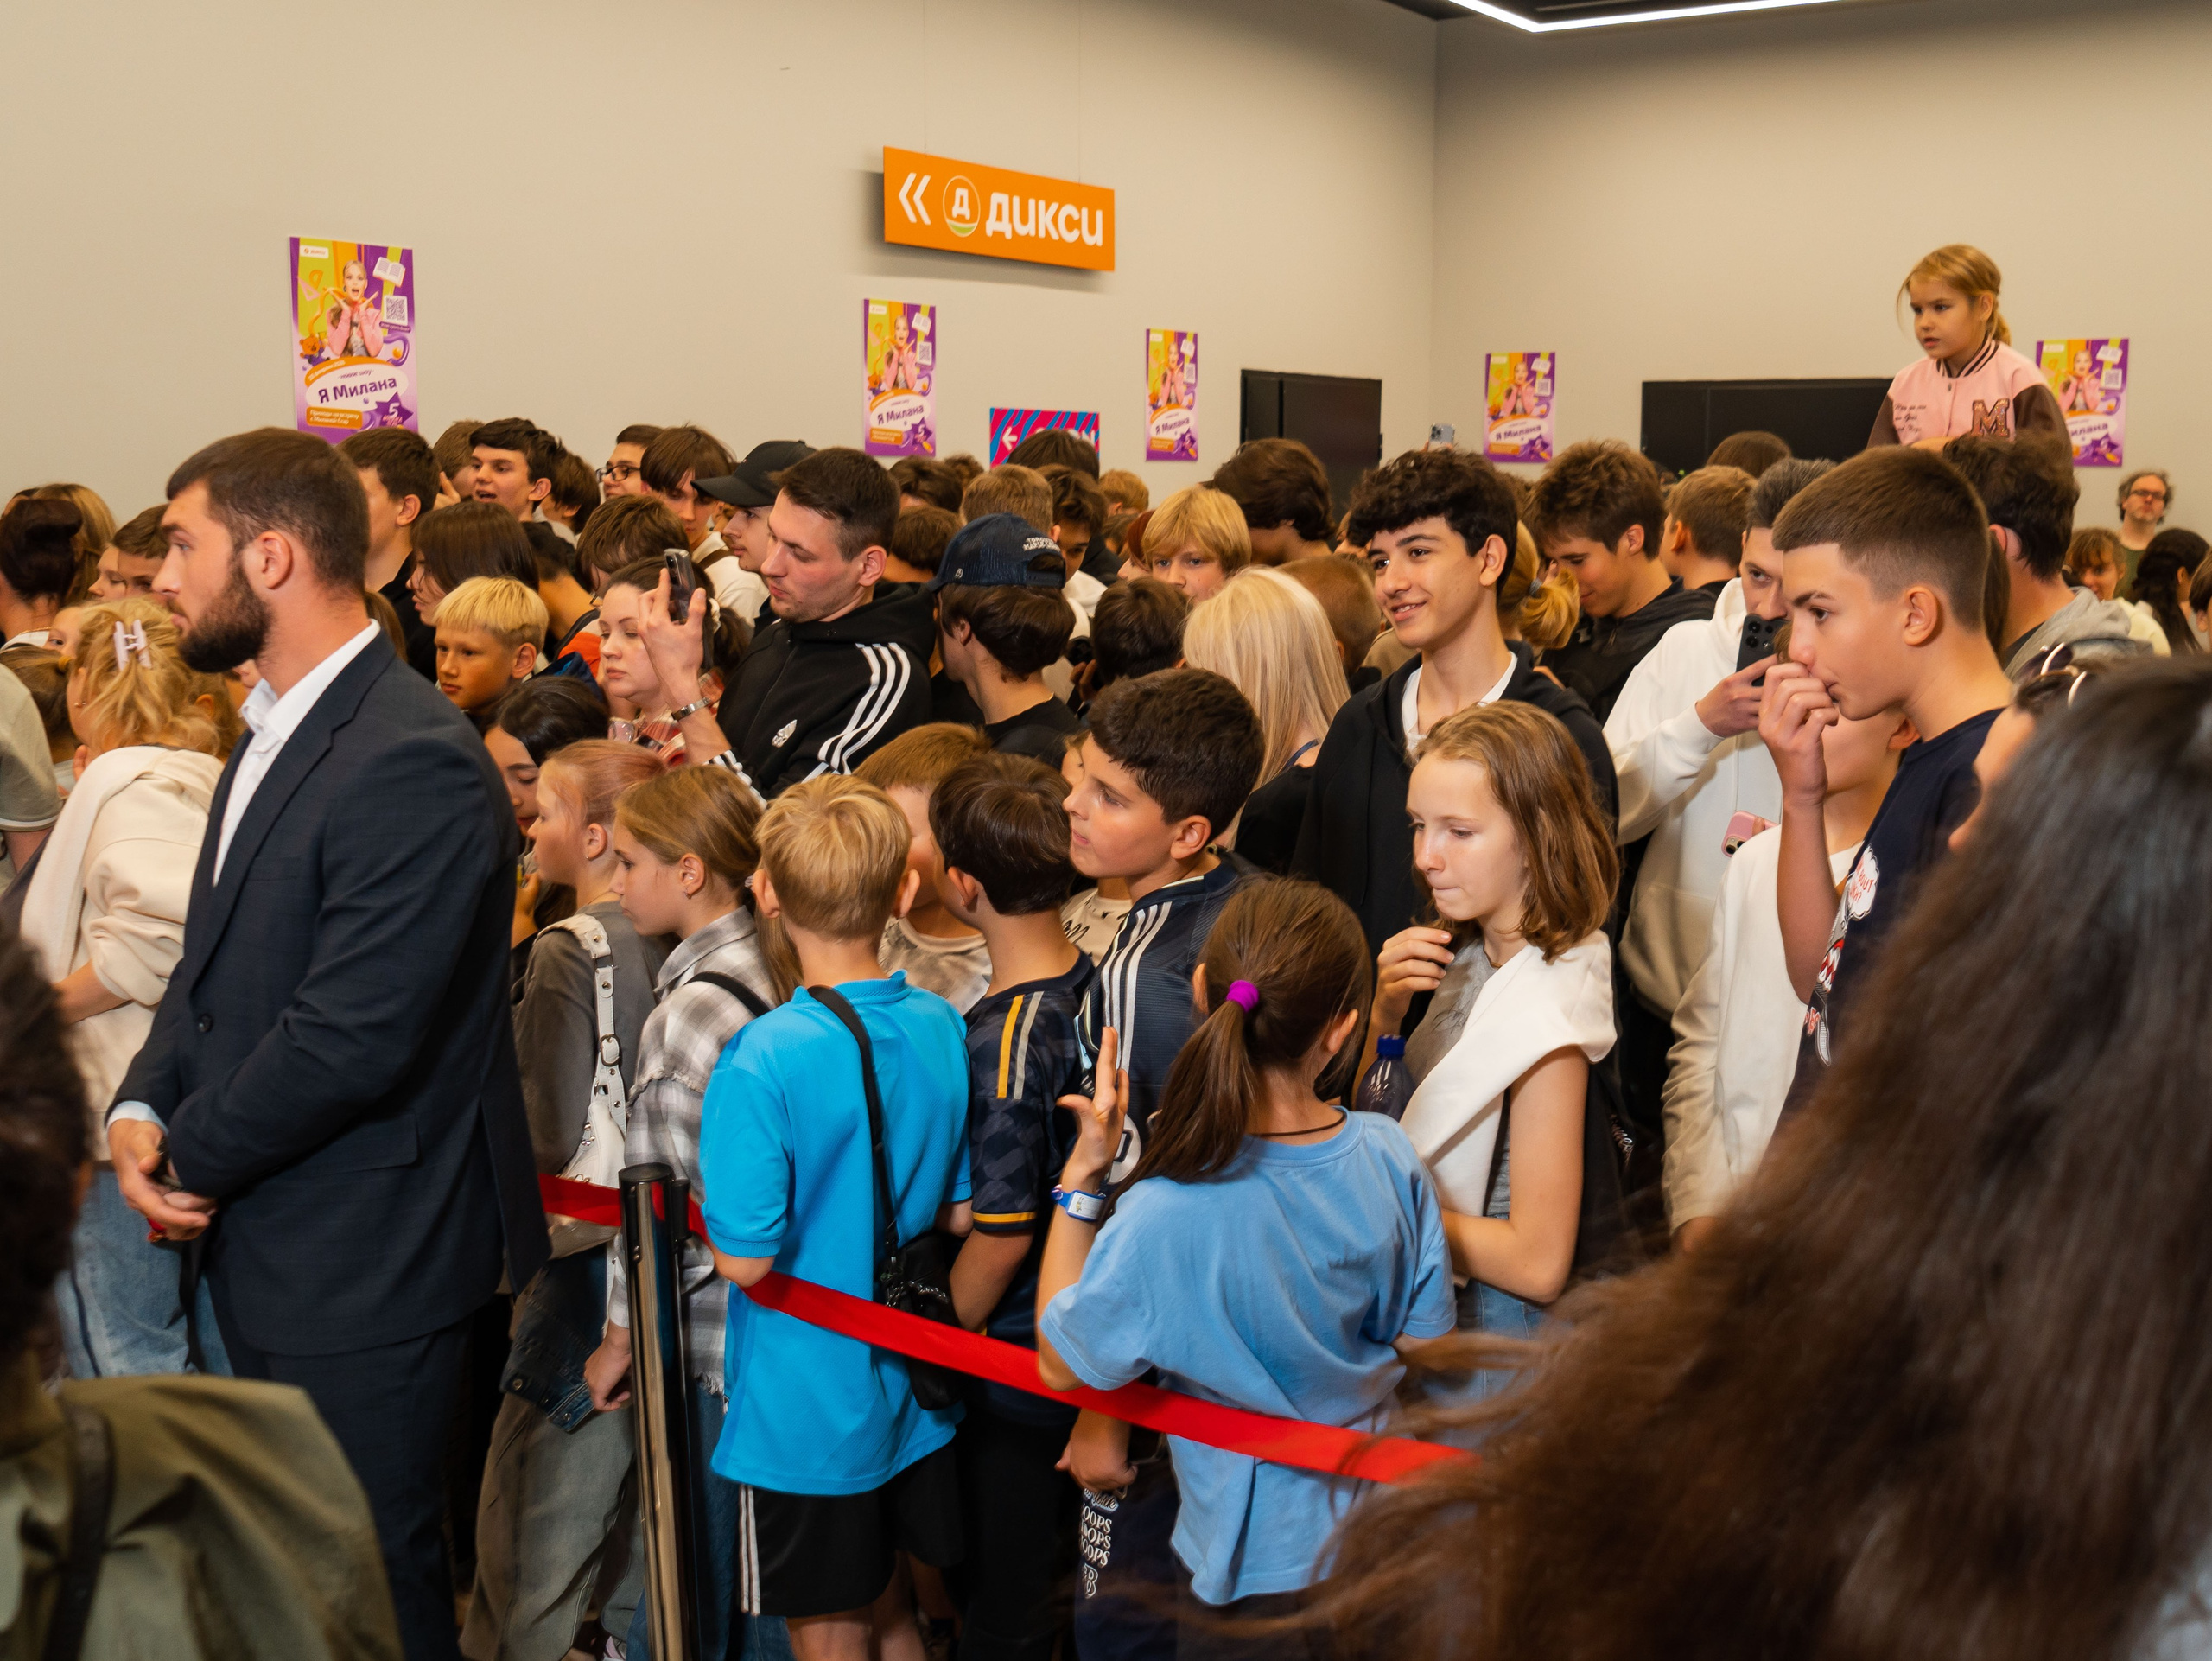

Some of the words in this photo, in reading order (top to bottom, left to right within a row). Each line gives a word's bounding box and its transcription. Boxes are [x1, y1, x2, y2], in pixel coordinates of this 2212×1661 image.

[318, 388, 330, 404] Я
[333, 378, 397, 400] Милана
[389, 402, 400, 418] 5
[877, 413, 884, 425] Я
[886, 404, 925, 423] Милана
[1970, 398, 2010, 437] M
[1503, 425, 1541, 439] Милана
[1083, 1505, 1113, 1533] OOPS
[1081, 1537, 1111, 1566] OOPS
